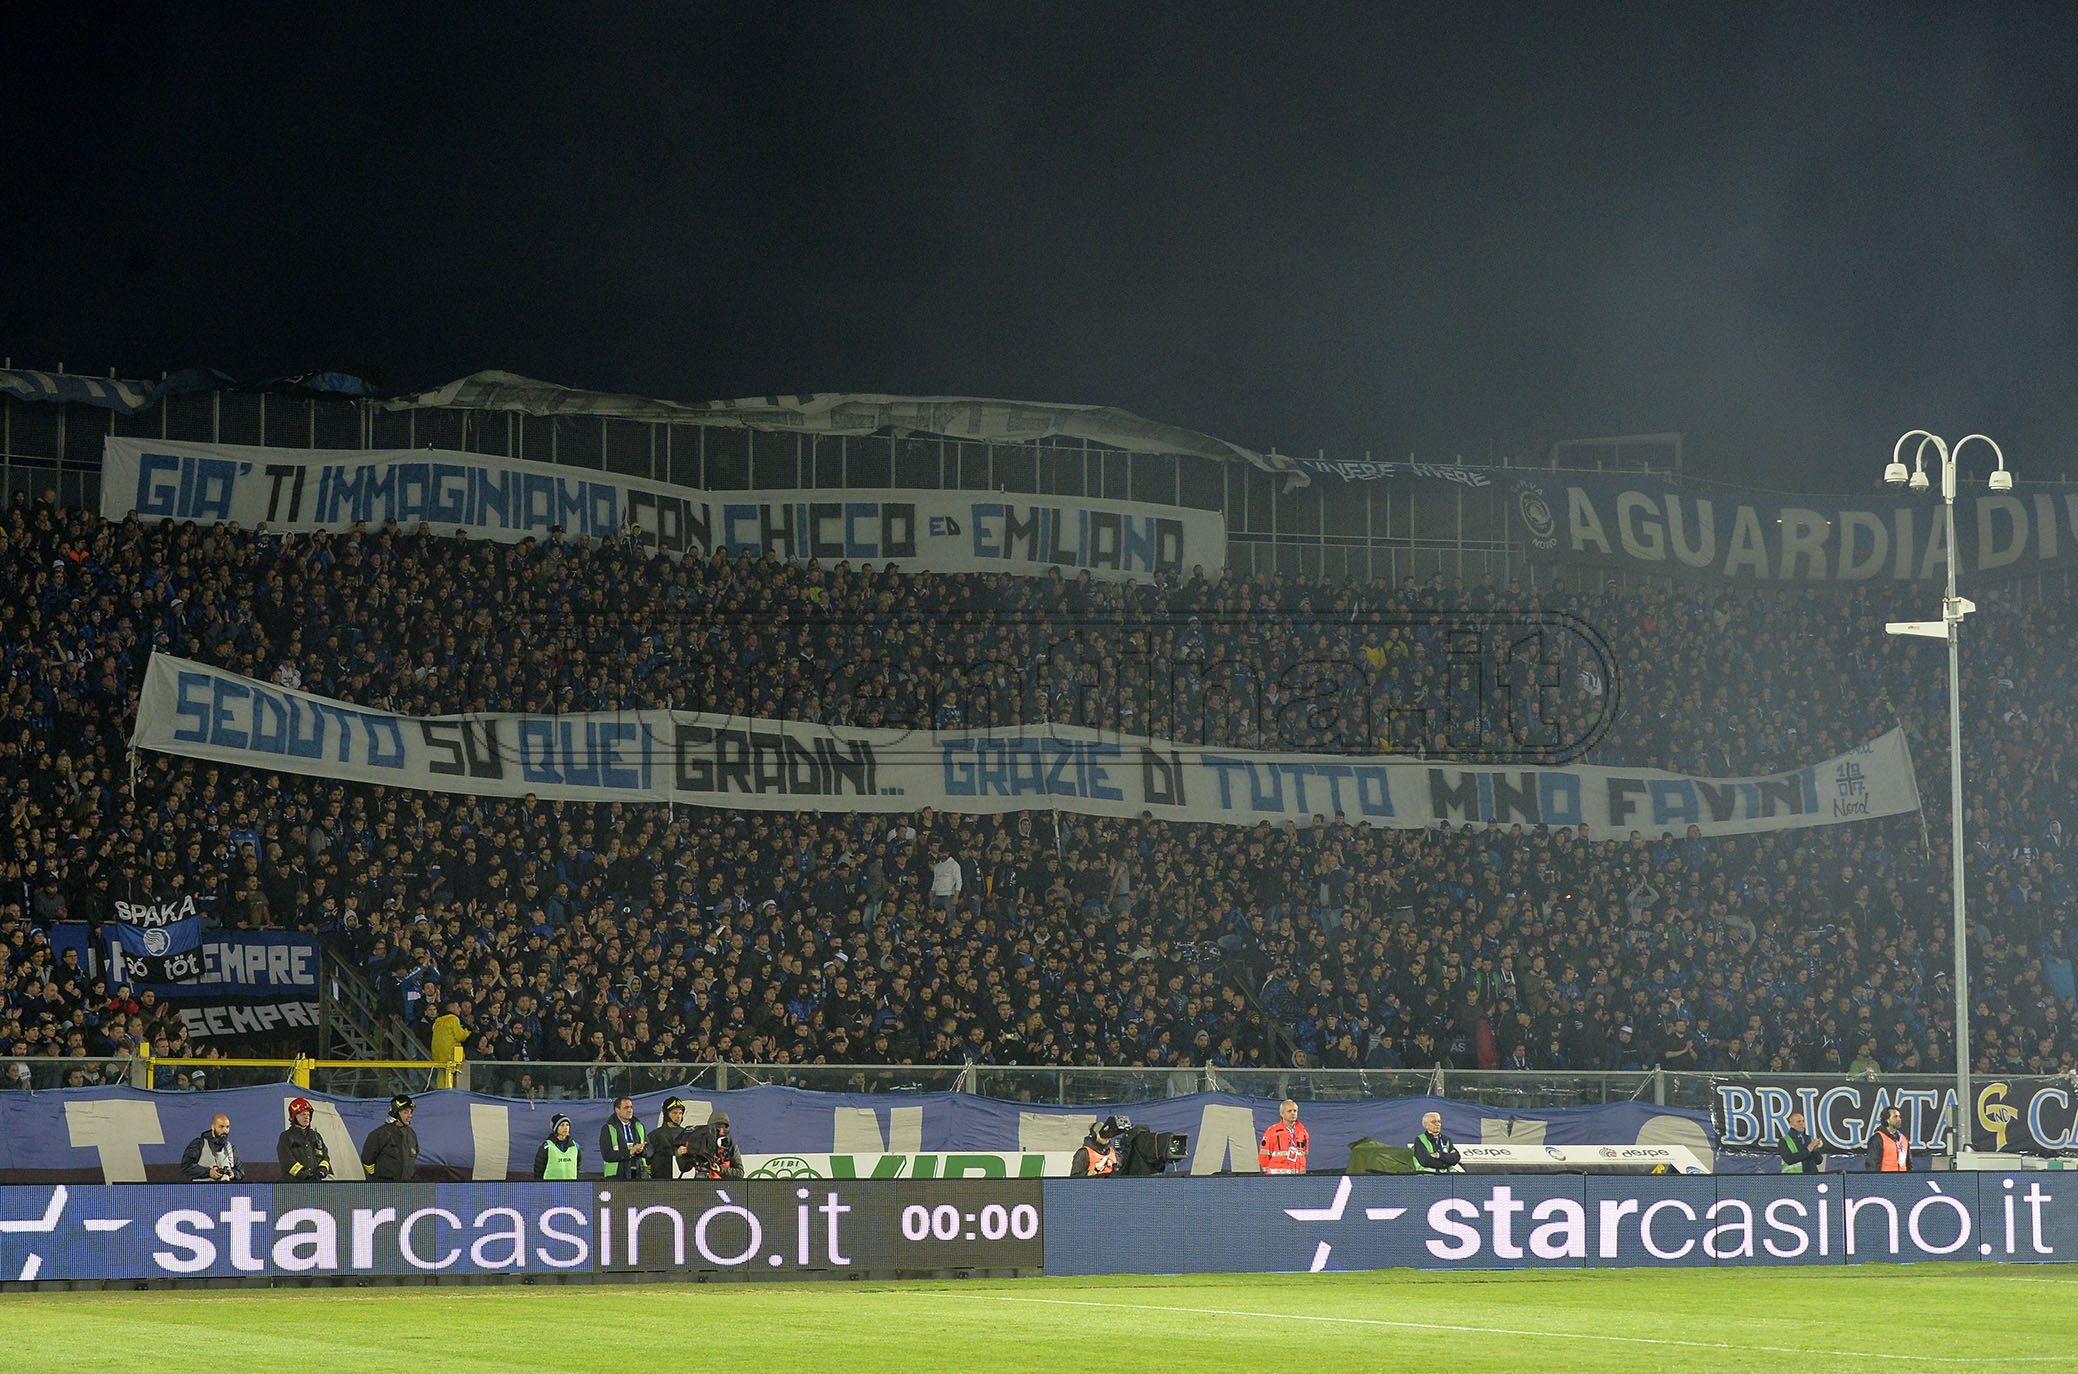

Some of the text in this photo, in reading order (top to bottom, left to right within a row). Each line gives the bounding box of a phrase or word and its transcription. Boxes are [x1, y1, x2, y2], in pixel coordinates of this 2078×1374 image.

[137, 453, 1184, 574] GIA' TI IMMAGINIAMO CON CHICCO ED EMILIANO
[174, 671, 405, 769] SEDUTO
[420, 720, 503, 780] SU
[518, 720, 651, 790] QUEI
[942, 737, 1124, 801] GRAZIE
[1140, 746, 1186, 806] DI
[1200, 754, 1395, 817] TUTTO
[1428, 768, 1582, 825] MINO
[1606, 768, 1819, 826] FAVINI
[164, 953, 200, 980] töt
[177, 943, 314, 985] EMPRE
[2027, 1088, 2078, 1150] C
[153, 1187, 1039, 1273] starcasinò.it 00:00
[1425, 1178, 2054, 1261] starcasinò.it
